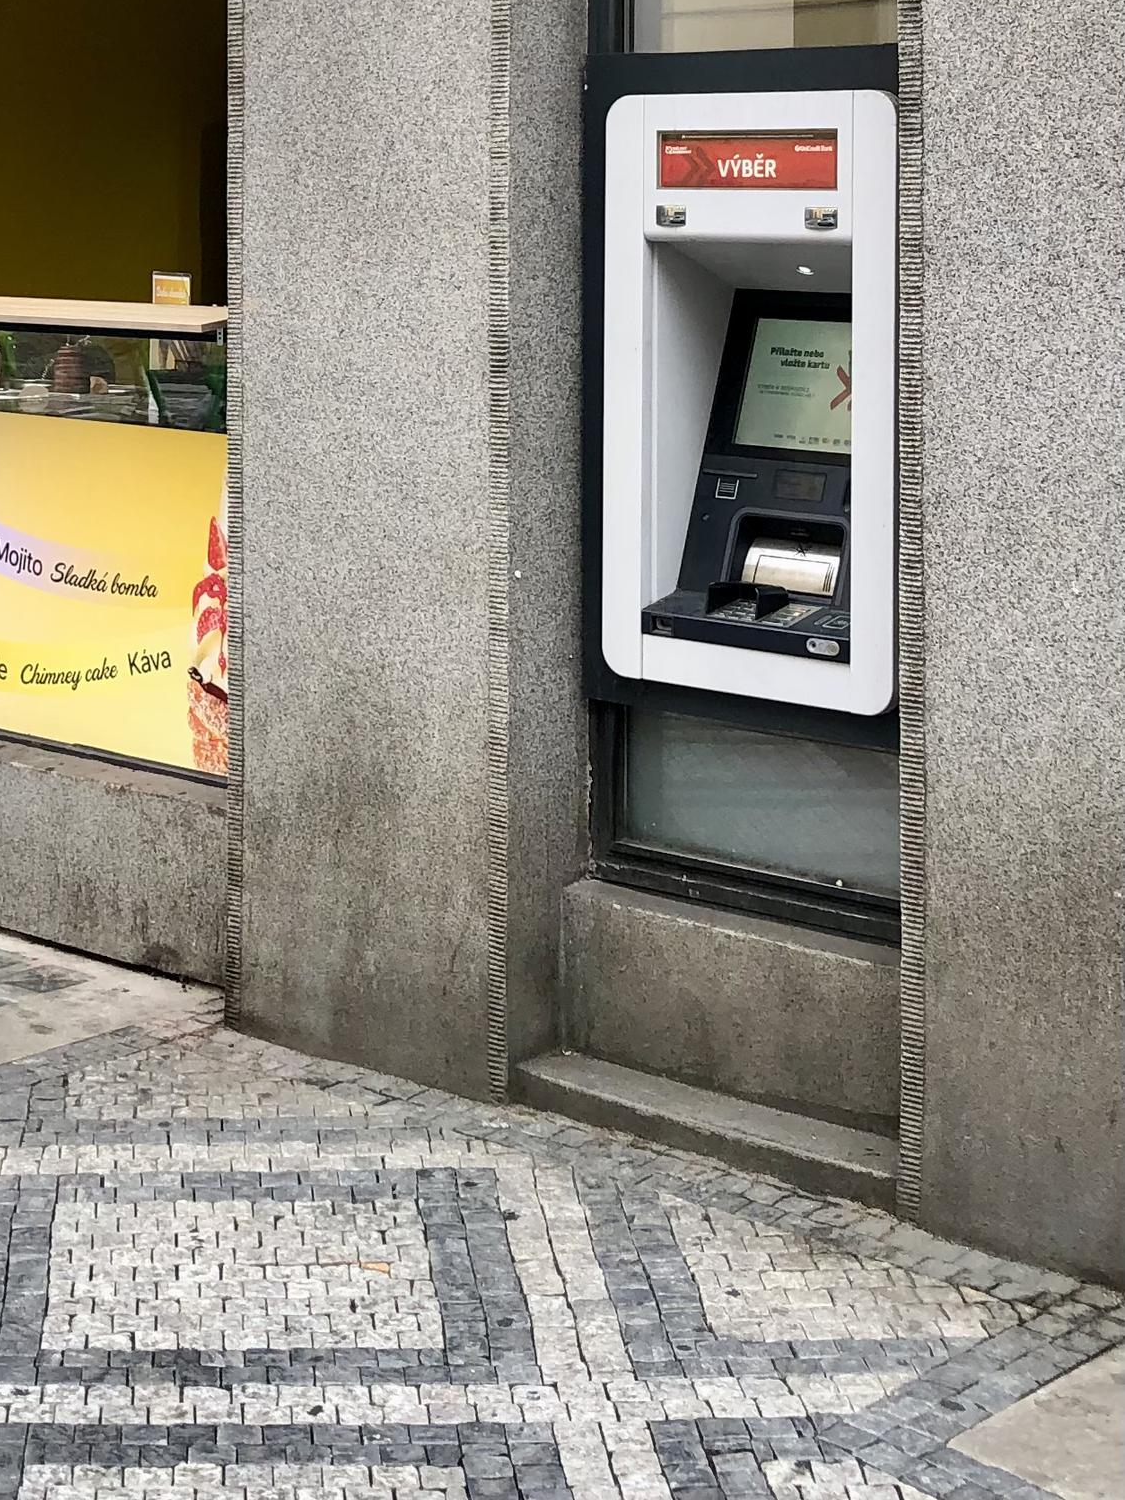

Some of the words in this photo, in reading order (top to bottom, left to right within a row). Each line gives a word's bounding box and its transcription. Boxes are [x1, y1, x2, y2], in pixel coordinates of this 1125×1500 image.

[717, 153, 776, 178] VÝBĚR
[804, 349, 824, 358] nebo
[807, 360, 830, 369] kartu
[50, 562, 108, 593] Sladká
[111, 572, 159, 598] bomba
[20, 664, 82, 691] Chimney
[85, 657, 119, 682] cake
[127, 649, 172, 675] Káva
